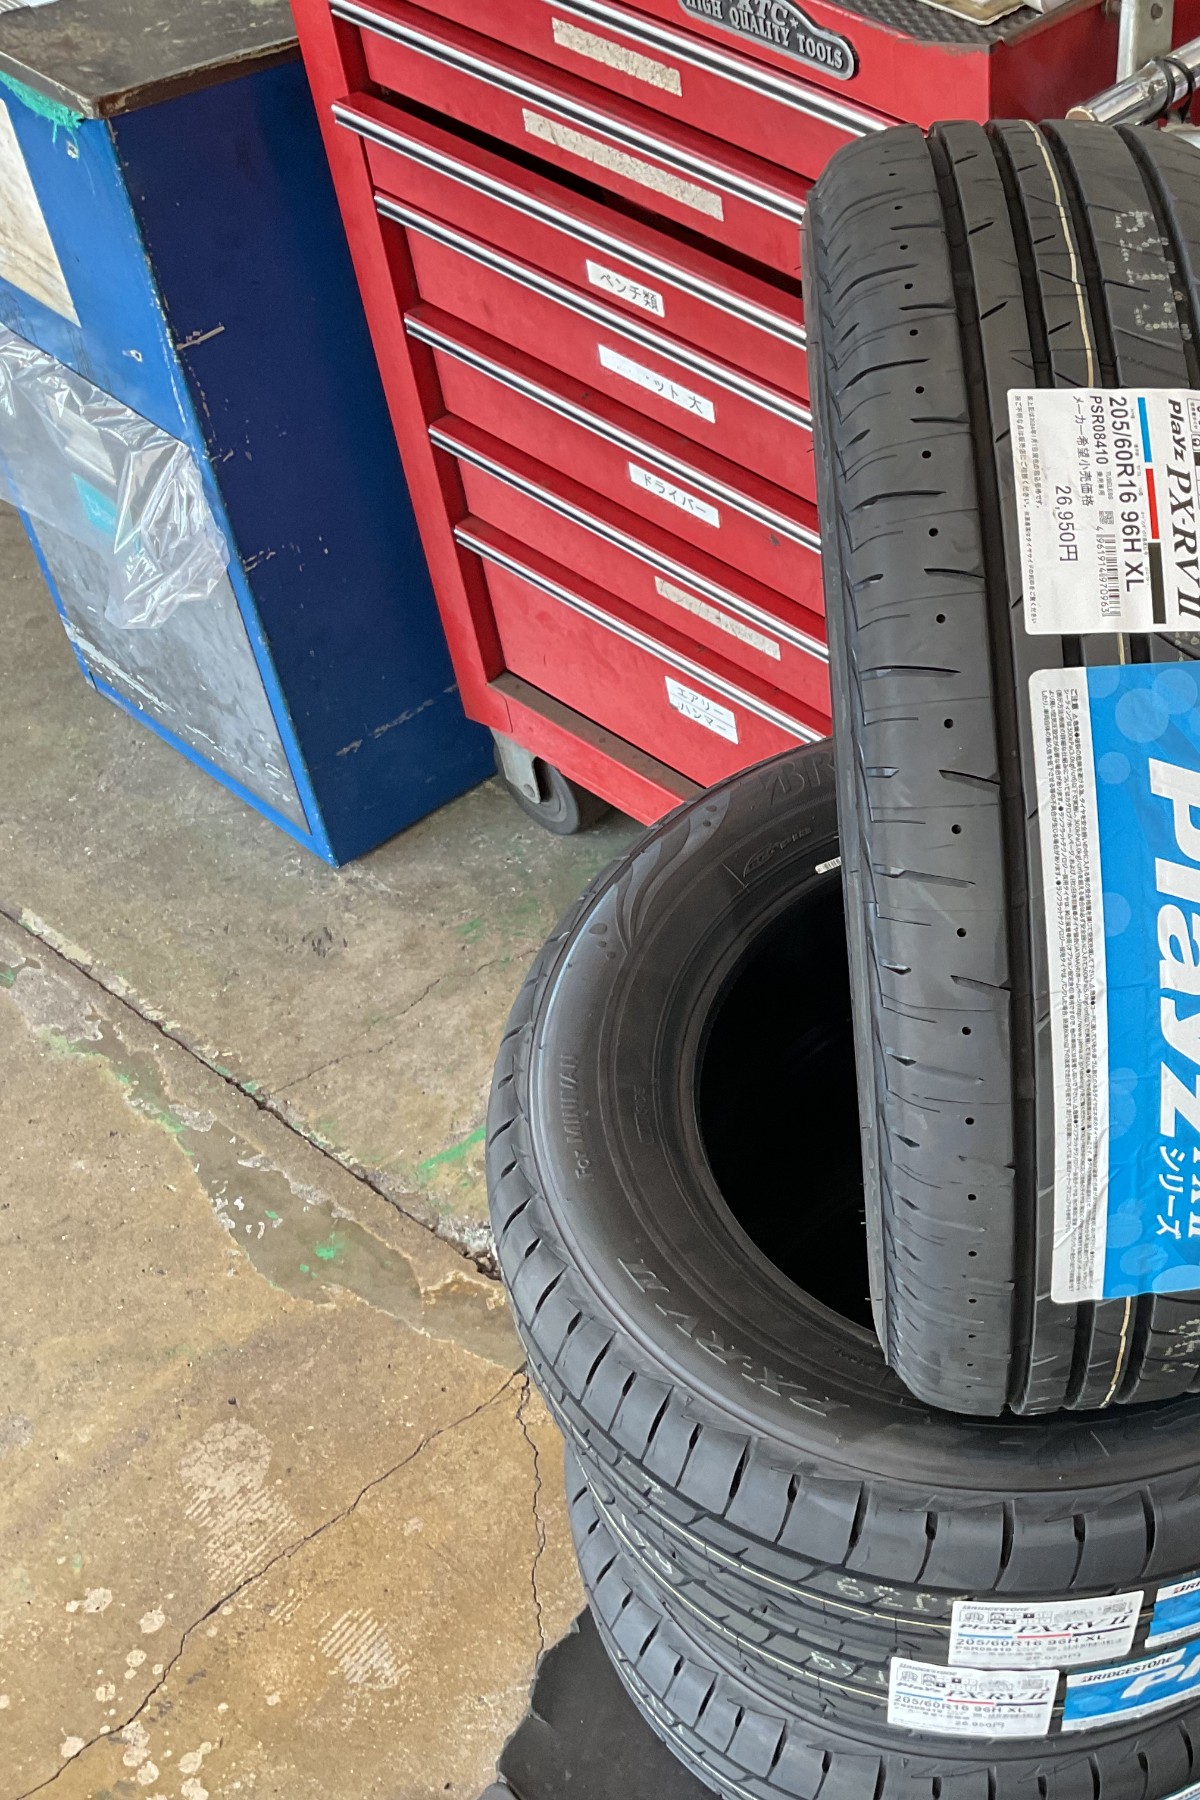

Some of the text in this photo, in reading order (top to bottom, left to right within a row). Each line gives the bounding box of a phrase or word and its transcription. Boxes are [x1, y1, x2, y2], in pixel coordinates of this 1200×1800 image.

[729, 7, 790, 48] QUALITY
[797, 32, 844, 70] TOOLS
[599, 273, 660, 313] ペンチ類
[1072, 395, 1094, 507] メーカー希望小売価格
[1089, 395, 1109, 466] PSR08410
[643, 473, 707, 514] ドライバー
[1055, 485, 1079, 562] 26,950円
[1108, 395, 1145, 593] 205/60R16 96H XL
[1166, 463, 1200, 586] PX-RV
[1155, 1145, 1191, 1241] シリーズ
[956, 1634, 1107, 1647] 205/60R16 96H XL
[1079, 1654, 1176, 1684] BRIDGESTONE
[894, 1694, 1027, 1714] 205/60R16 96H XL
